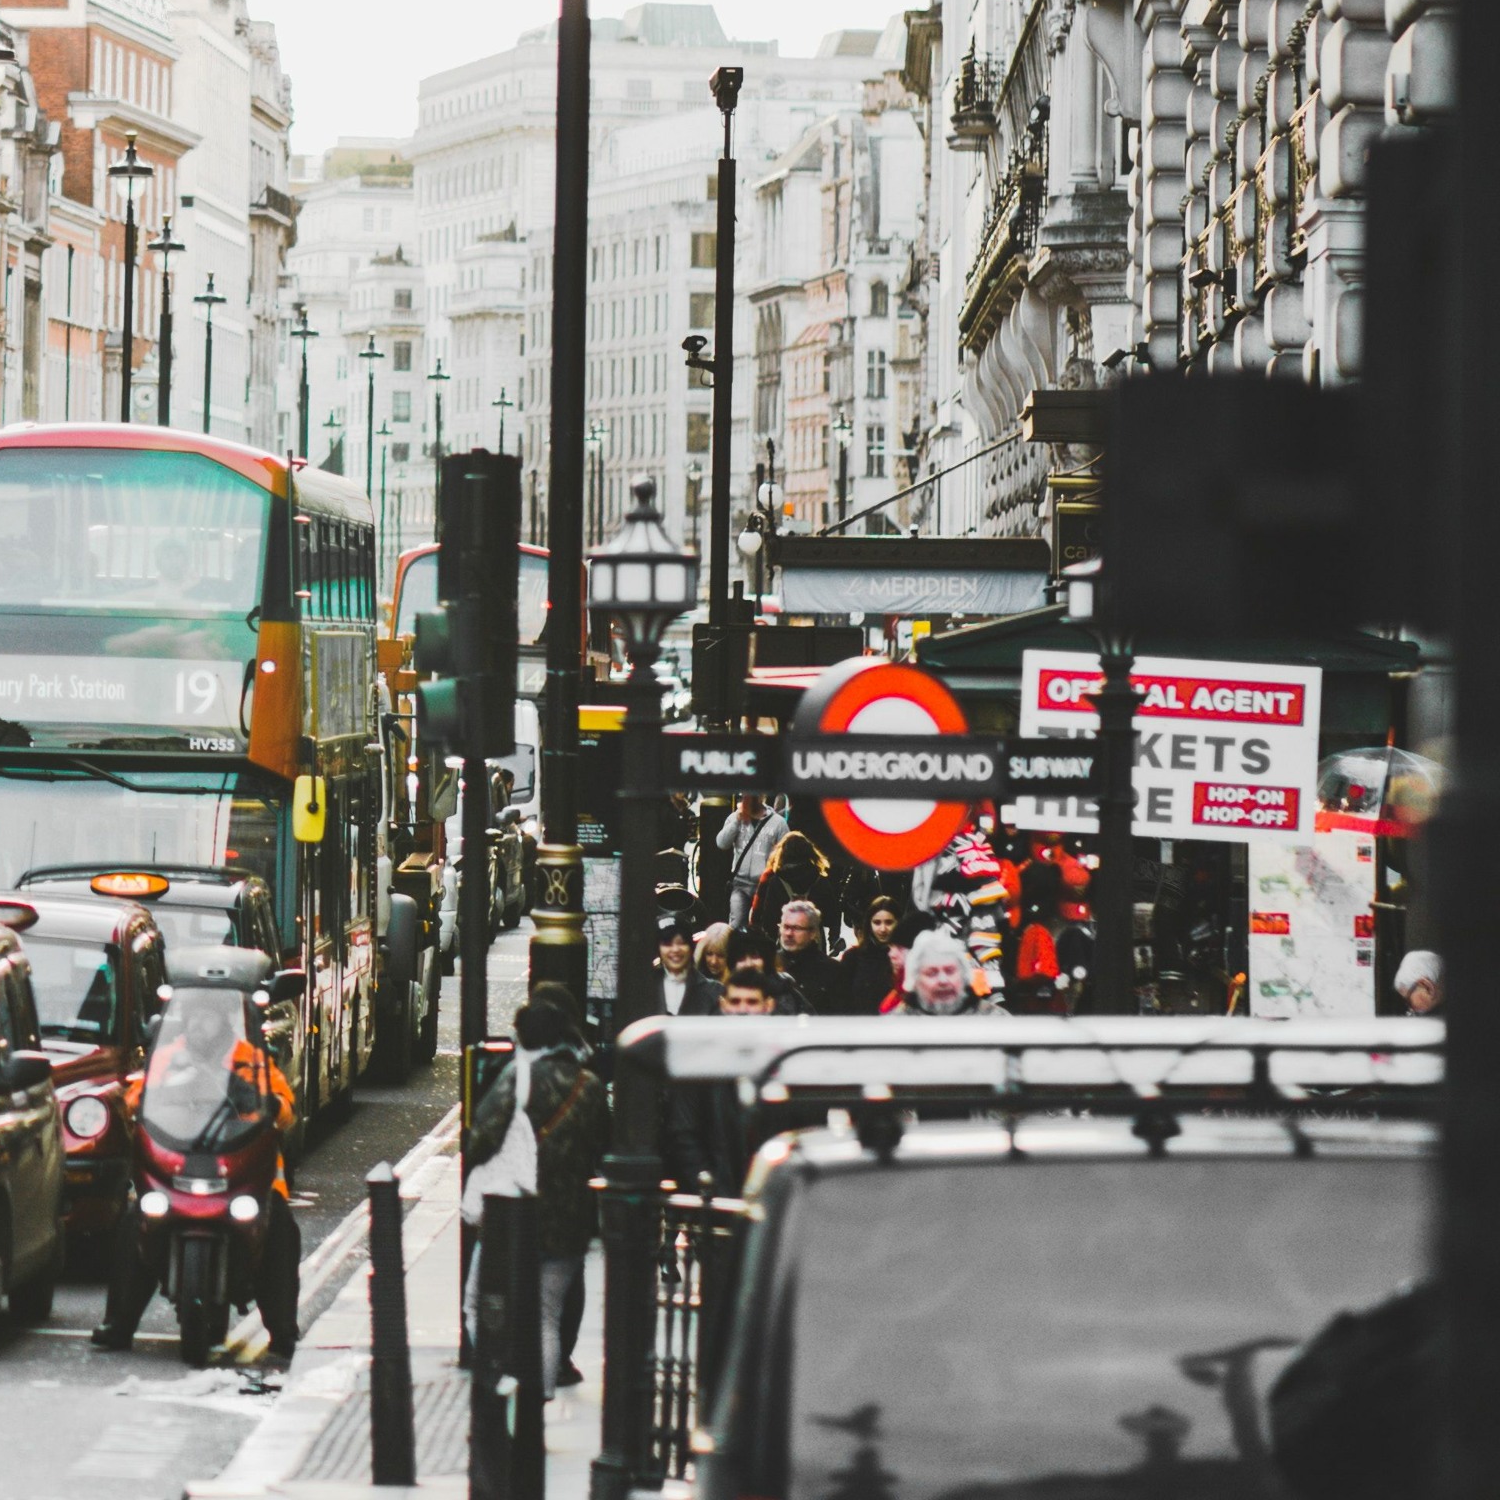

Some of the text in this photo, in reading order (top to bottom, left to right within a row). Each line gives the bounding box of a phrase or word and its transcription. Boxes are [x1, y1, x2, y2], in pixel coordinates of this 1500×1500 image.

[869, 576, 979, 597] MERIDIEN
[29, 673, 63, 699] Park
[69, 674, 126, 700] Station
[175, 669, 218, 715] 19
[1047, 677, 1296, 716] OFFAL AGENT
[189, 737, 236, 751] HV355
[680, 750, 757, 776] PUBLIC
[792, 751, 995, 781] UNDERGROUND
[1008, 756, 1095, 780] SUBWAY
[1207, 786, 1285, 806] HOP-ON
[1203, 805, 1289, 826] HOP-OFF
